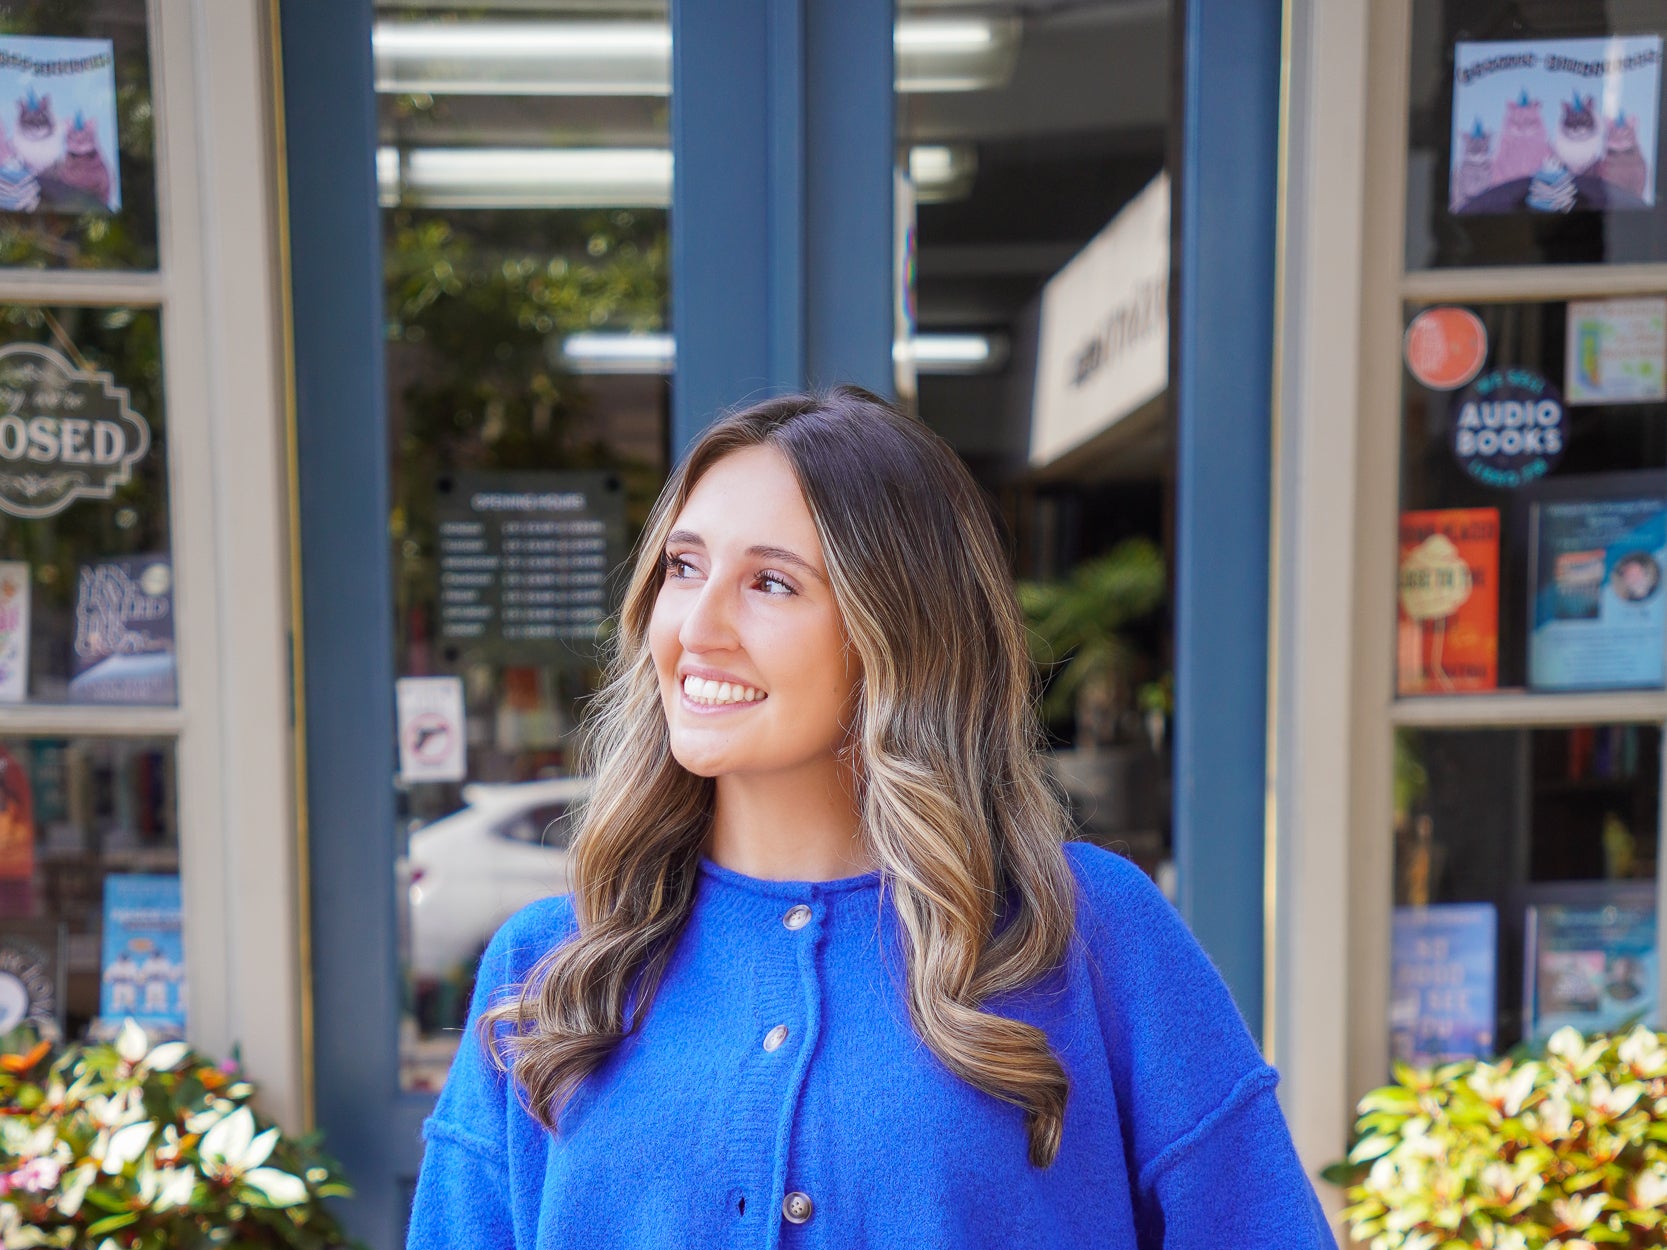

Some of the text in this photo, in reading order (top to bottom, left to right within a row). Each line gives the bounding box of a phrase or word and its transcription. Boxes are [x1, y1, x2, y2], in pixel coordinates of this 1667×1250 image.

[1458, 399, 1561, 427] AUDIO
[0, 414, 125, 465] OSED
[1456, 428, 1561, 457] BOOKS
